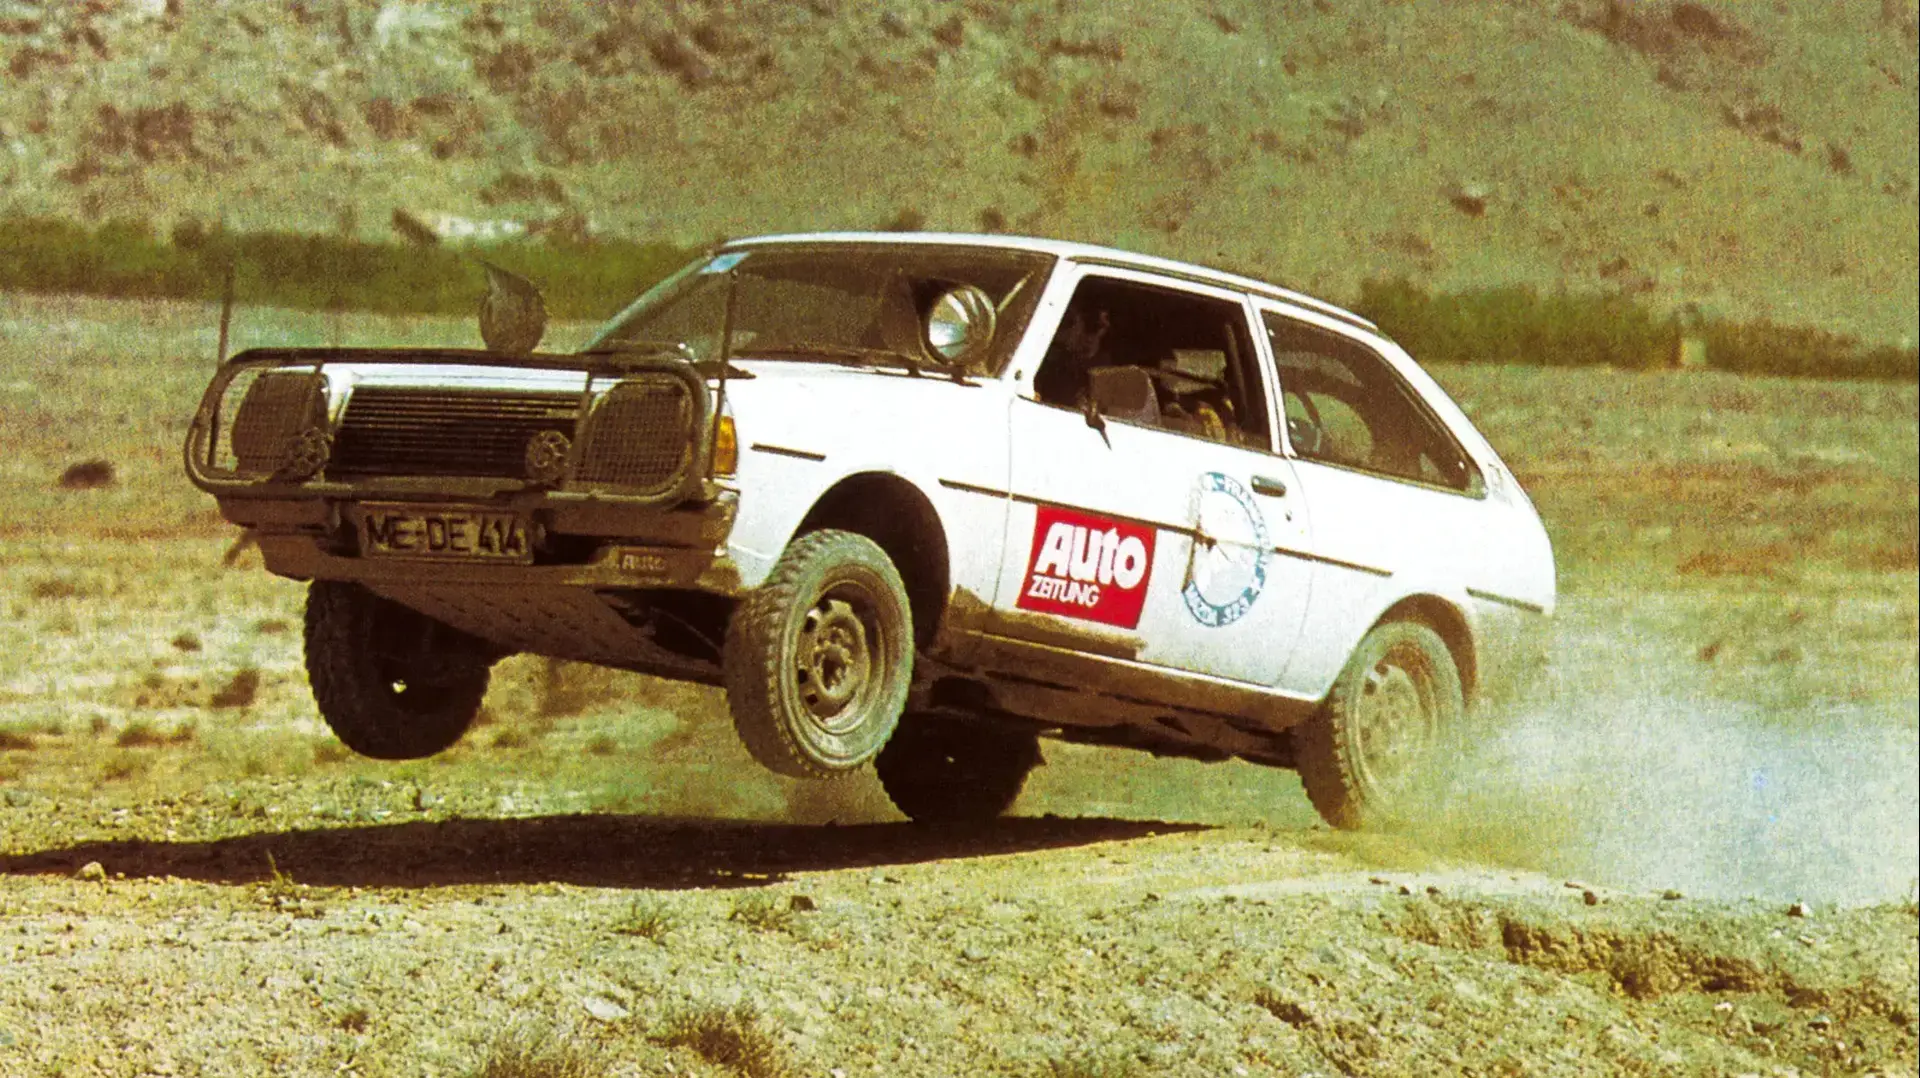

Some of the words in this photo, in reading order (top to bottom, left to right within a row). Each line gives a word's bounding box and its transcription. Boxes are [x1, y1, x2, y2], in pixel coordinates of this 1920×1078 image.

[366, 514, 471, 551] ME-DE
[478, 513, 527, 554] 414
[1027, 574, 1101, 608] ZEITUNG
